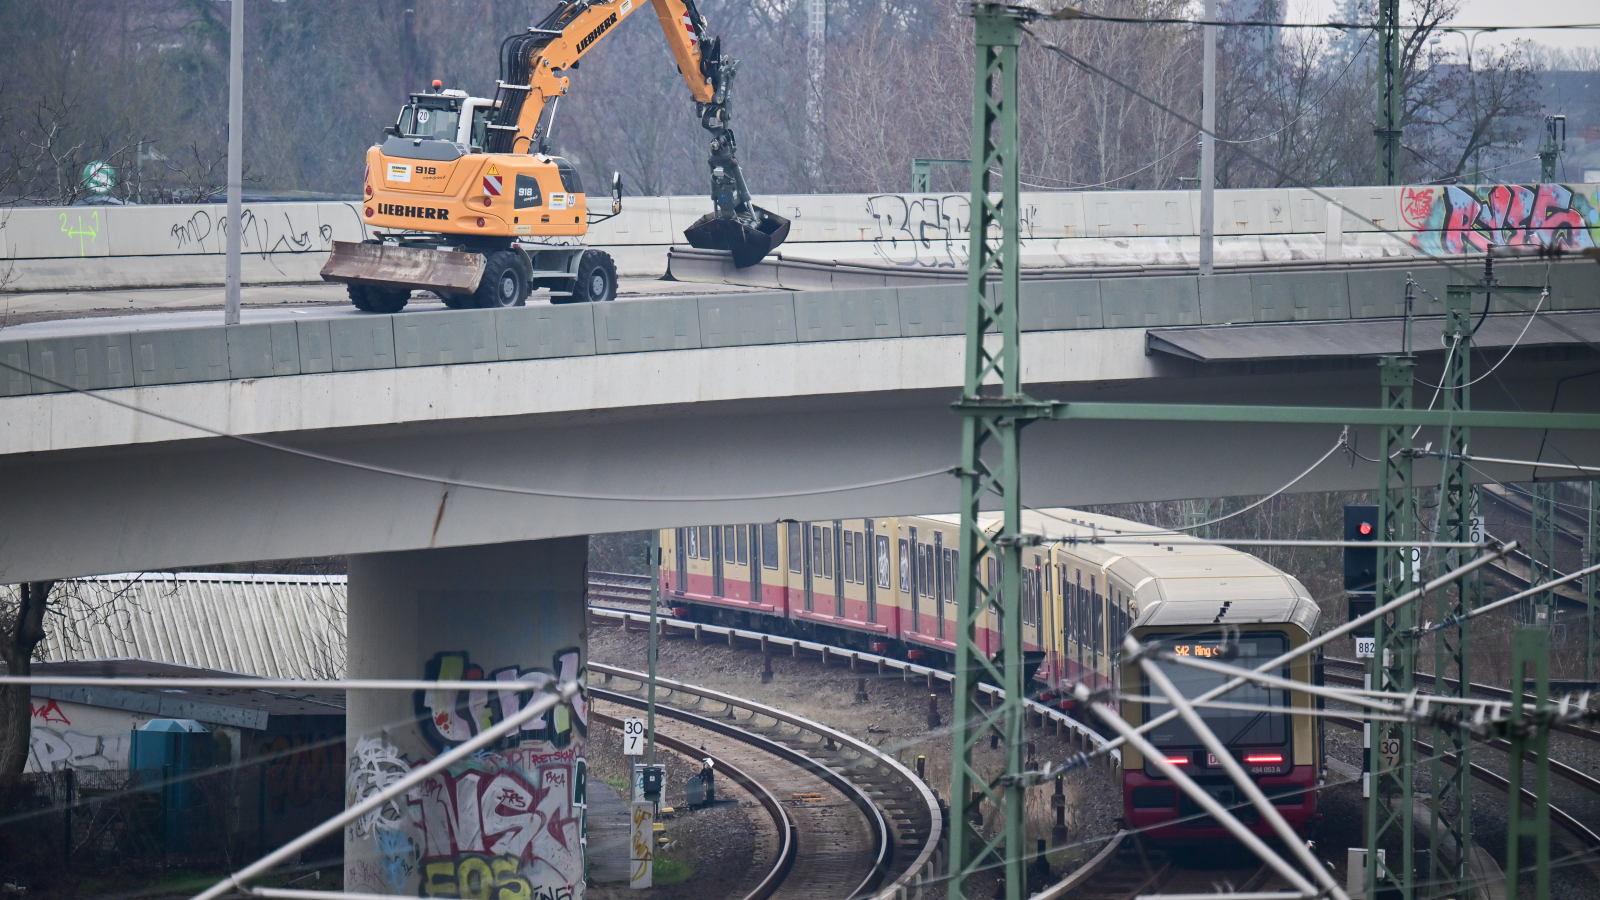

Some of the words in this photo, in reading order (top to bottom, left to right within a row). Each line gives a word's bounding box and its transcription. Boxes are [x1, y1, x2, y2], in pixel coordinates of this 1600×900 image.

[575, 12, 618, 55] LIEBHERR
[419, 110, 428, 121] 20
[415, 165, 437, 175] 918
[90, 162, 111, 192] S
[518, 188, 533, 196] 918
[568, 195, 575, 205] 20
[377, 202, 450, 220] LIEBHERR
[59, 212, 68, 232] 2
[1175, 645, 1190, 657] S42
[1194, 645, 1211, 658] Ring
[1358, 642, 1375, 653] 882
[625, 721, 643, 735] 30
[630, 736, 638, 750] 7
[1381, 741, 1399, 755] 30
[1385, 756, 1393, 768] 7
